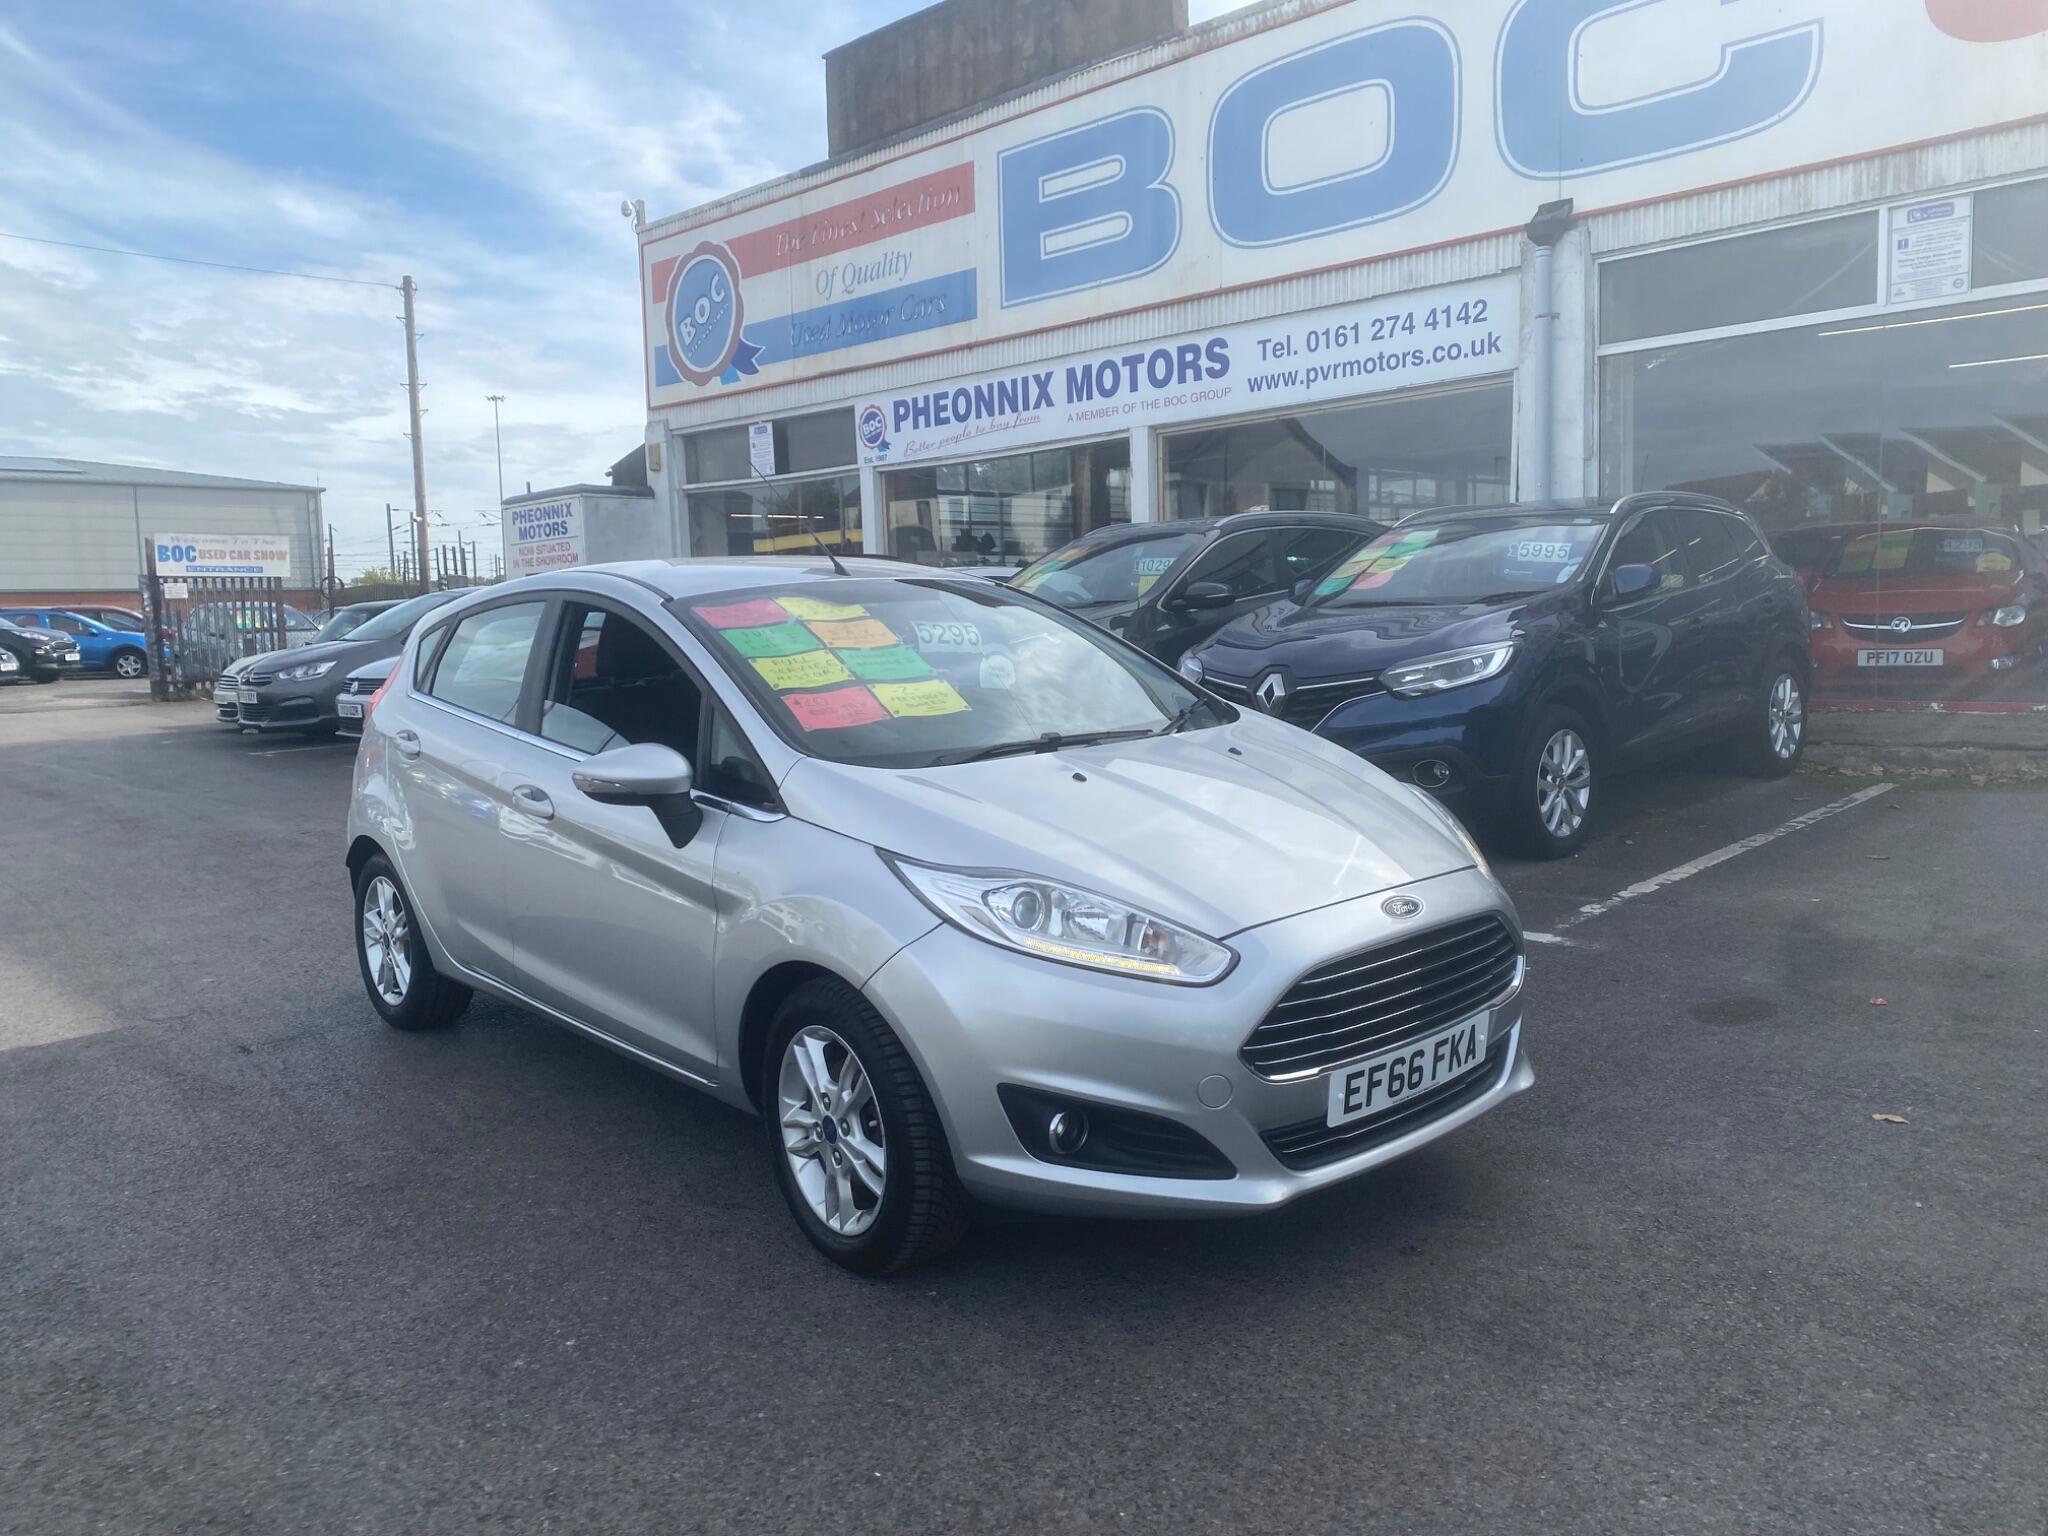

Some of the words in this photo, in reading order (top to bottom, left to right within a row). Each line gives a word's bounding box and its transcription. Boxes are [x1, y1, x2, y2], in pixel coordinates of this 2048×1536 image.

[998, 0, 1823, 309] BOC
[816, 266, 839, 301] Of
[842, 251, 913, 295] Quality
[680, 272, 725, 346] BOC
[789, 316, 832, 348] Used
[900, 292, 949, 323] Cars
[1257, 334, 1299, 361] Tel.
[1305, 321, 1361, 354] 0161
[1370, 311, 1417, 342] 274
[1424, 299, 1489, 331] 4142
[1247, 331, 1503, 393] www.pvrmotors.co.uk
[893, 370, 1056, 434] PHEONNIX
[1066, 337, 1231, 404] MOTORS
[1067, 414, 1076, 424] A
[1076, 405, 1120, 422] MEMBER
[1122, 402, 1138, 415] OF
[1140, 398, 1164, 412] THE
[1164, 394, 1189, 408] BOC
[1190, 387, 1233, 404] GROUP
[863, 416, 883, 436] BOC
[938, 423, 972, 450] people
[975, 425, 986, 436] to
[989, 417, 1010, 433] buy
[1012, 410, 1041, 429] from
[512, 503, 573, 526] PHEONNIX
[518, 520, 569, 541] MOTORS
[157, 544, 197, 563] BOC
[198, 549, 227, 561] USED
[229, 549, 252, 561] CAR
[253, 549, 288, 561] SHOW
[512, 559, 520, 569] IN
[520, 556, 535, 568] THE
[535, 551, 579, 567] SHOWROOM
[518, 545, 535, 557] NOW
[535, 541, 571, 555] SITUATED
[916, 623, 981, 646] 5295
[1866, 651, 1900, 664] PF17
[1392, 901, 1416, 914] Ford
[1343, 1048, 1425, 1115] EF66
[1431, 1024, 1477, 1082] FKA
